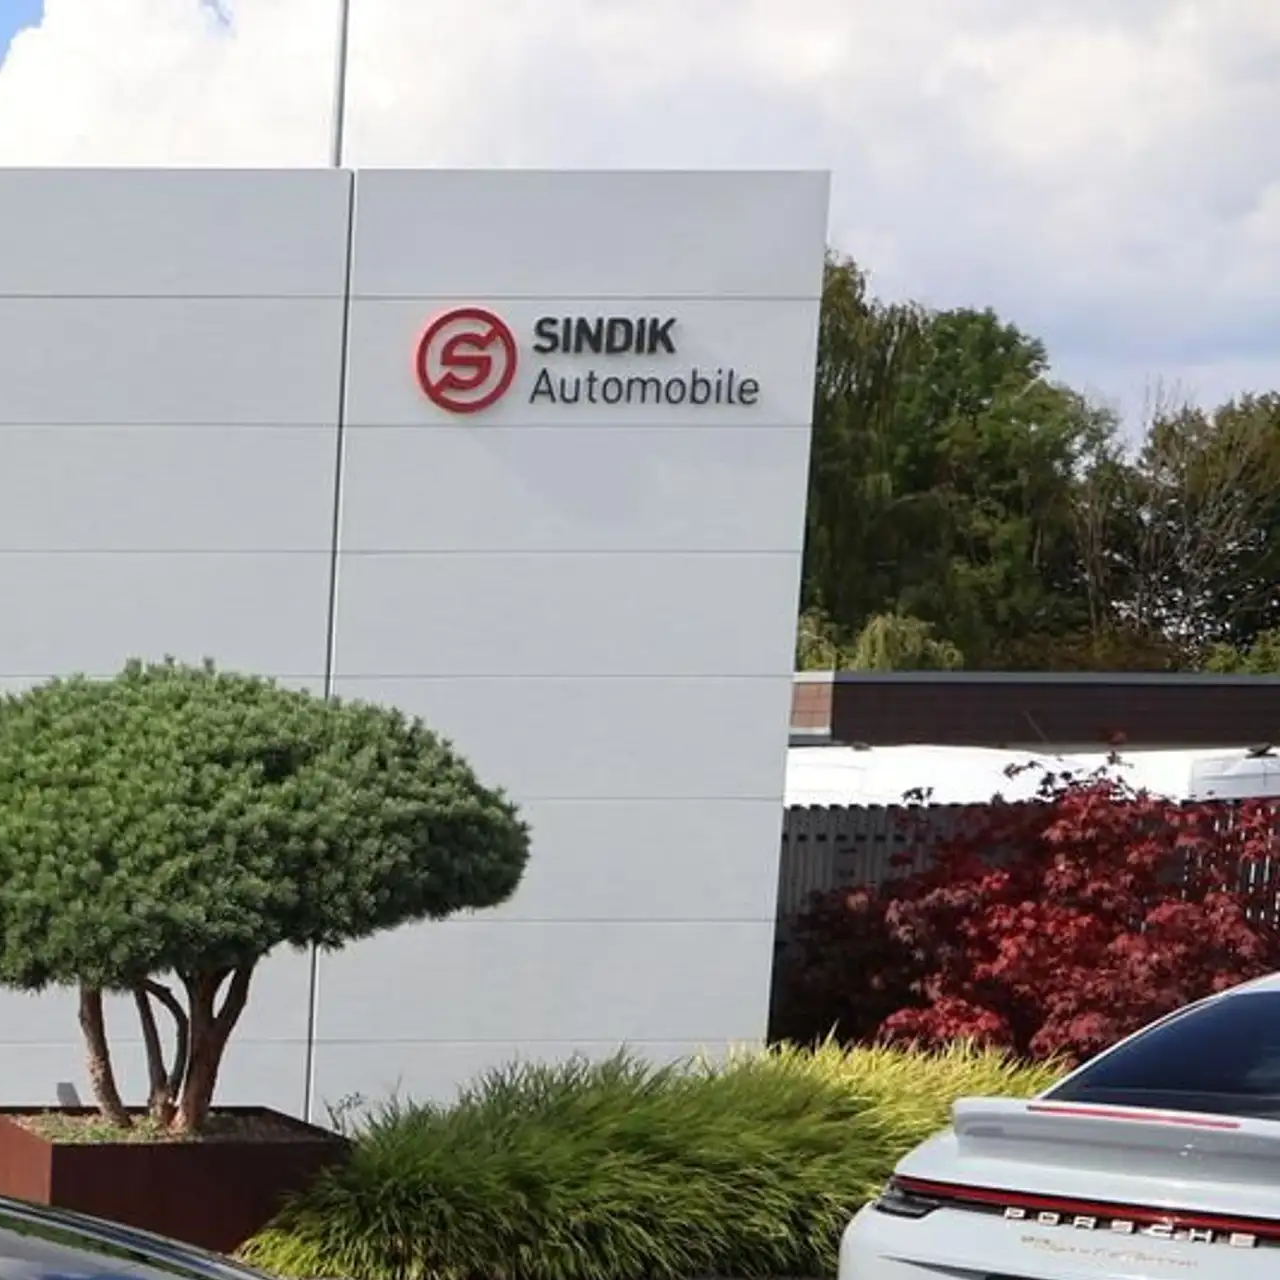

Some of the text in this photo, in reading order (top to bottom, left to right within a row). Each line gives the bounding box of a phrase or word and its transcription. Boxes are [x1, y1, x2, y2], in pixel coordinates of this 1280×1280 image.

[532, 317, 678, 355] SINDIK
[528, 367, 761, 406] Automobile
[1003, 1205, 1257, 1248] PORSCHE
